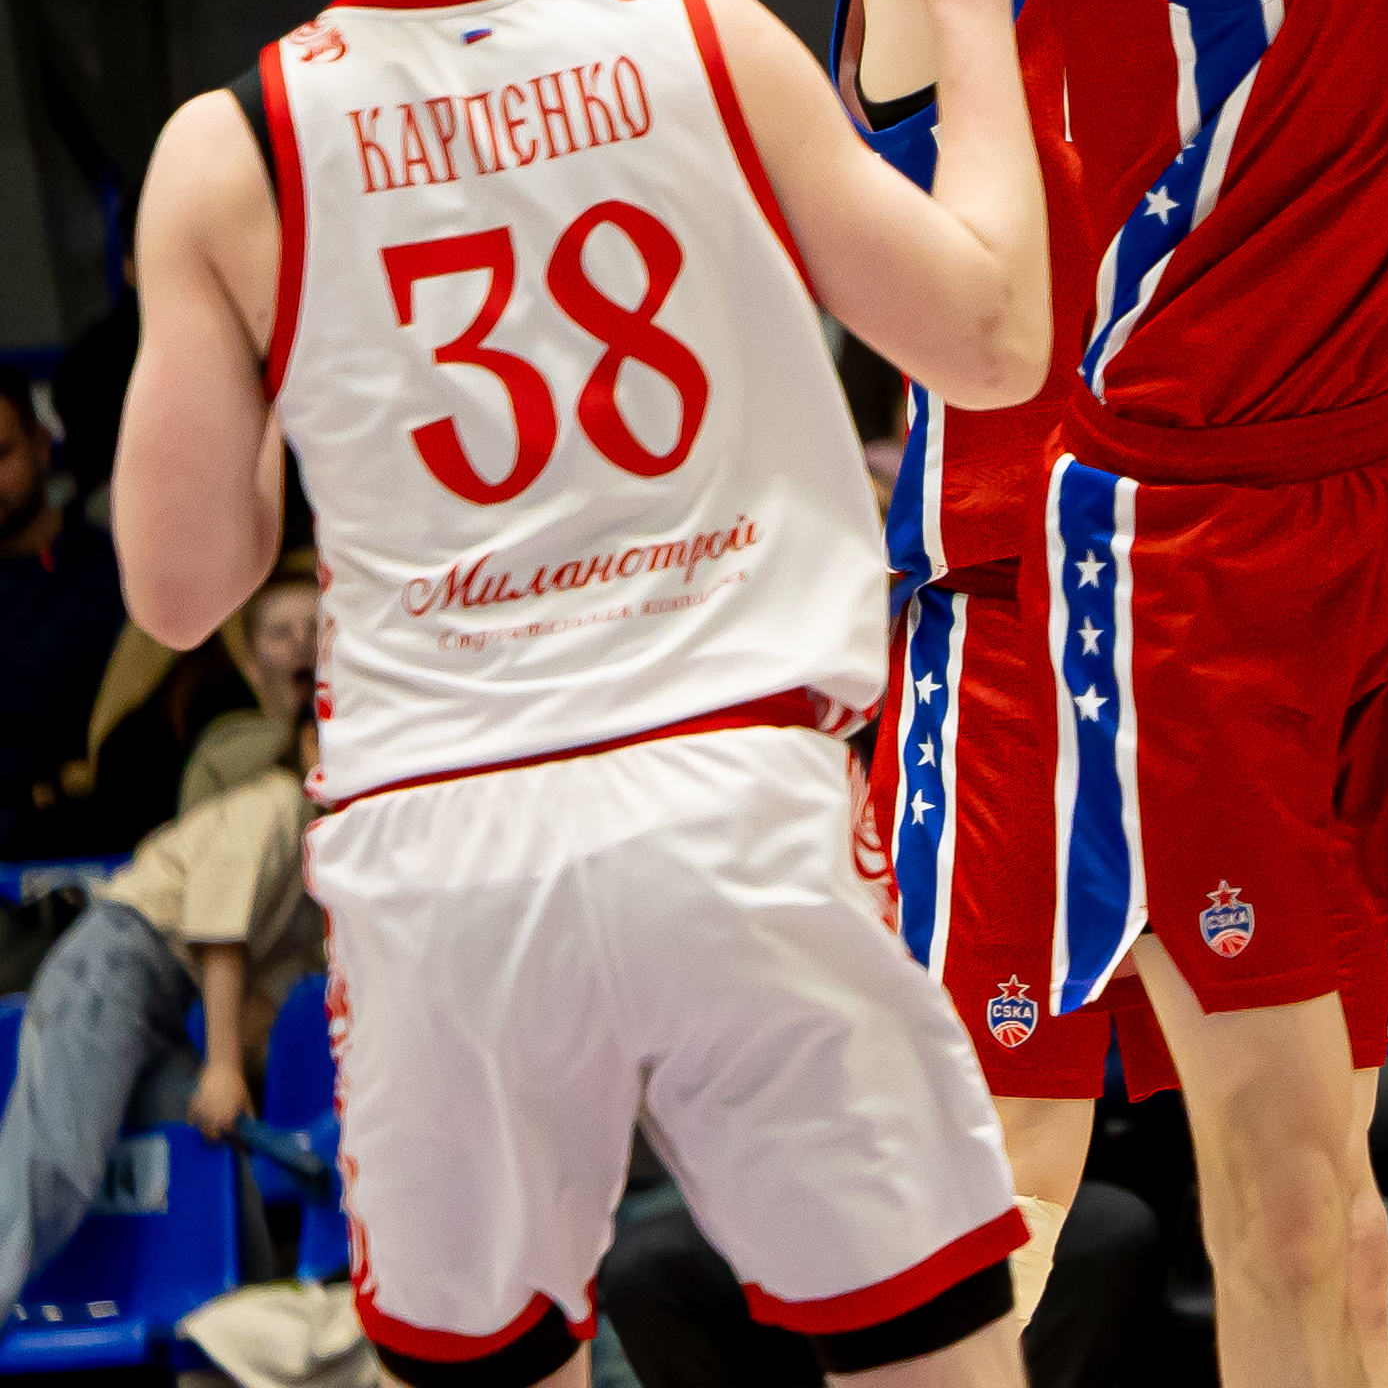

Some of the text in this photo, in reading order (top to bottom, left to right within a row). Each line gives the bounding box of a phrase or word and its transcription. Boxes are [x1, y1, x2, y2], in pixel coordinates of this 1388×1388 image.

[347, 54, 654, 194] КАРПЕНКО
[380, 199, 711, 506] 38
[992, 1004, 1033, 1019] CSKA
